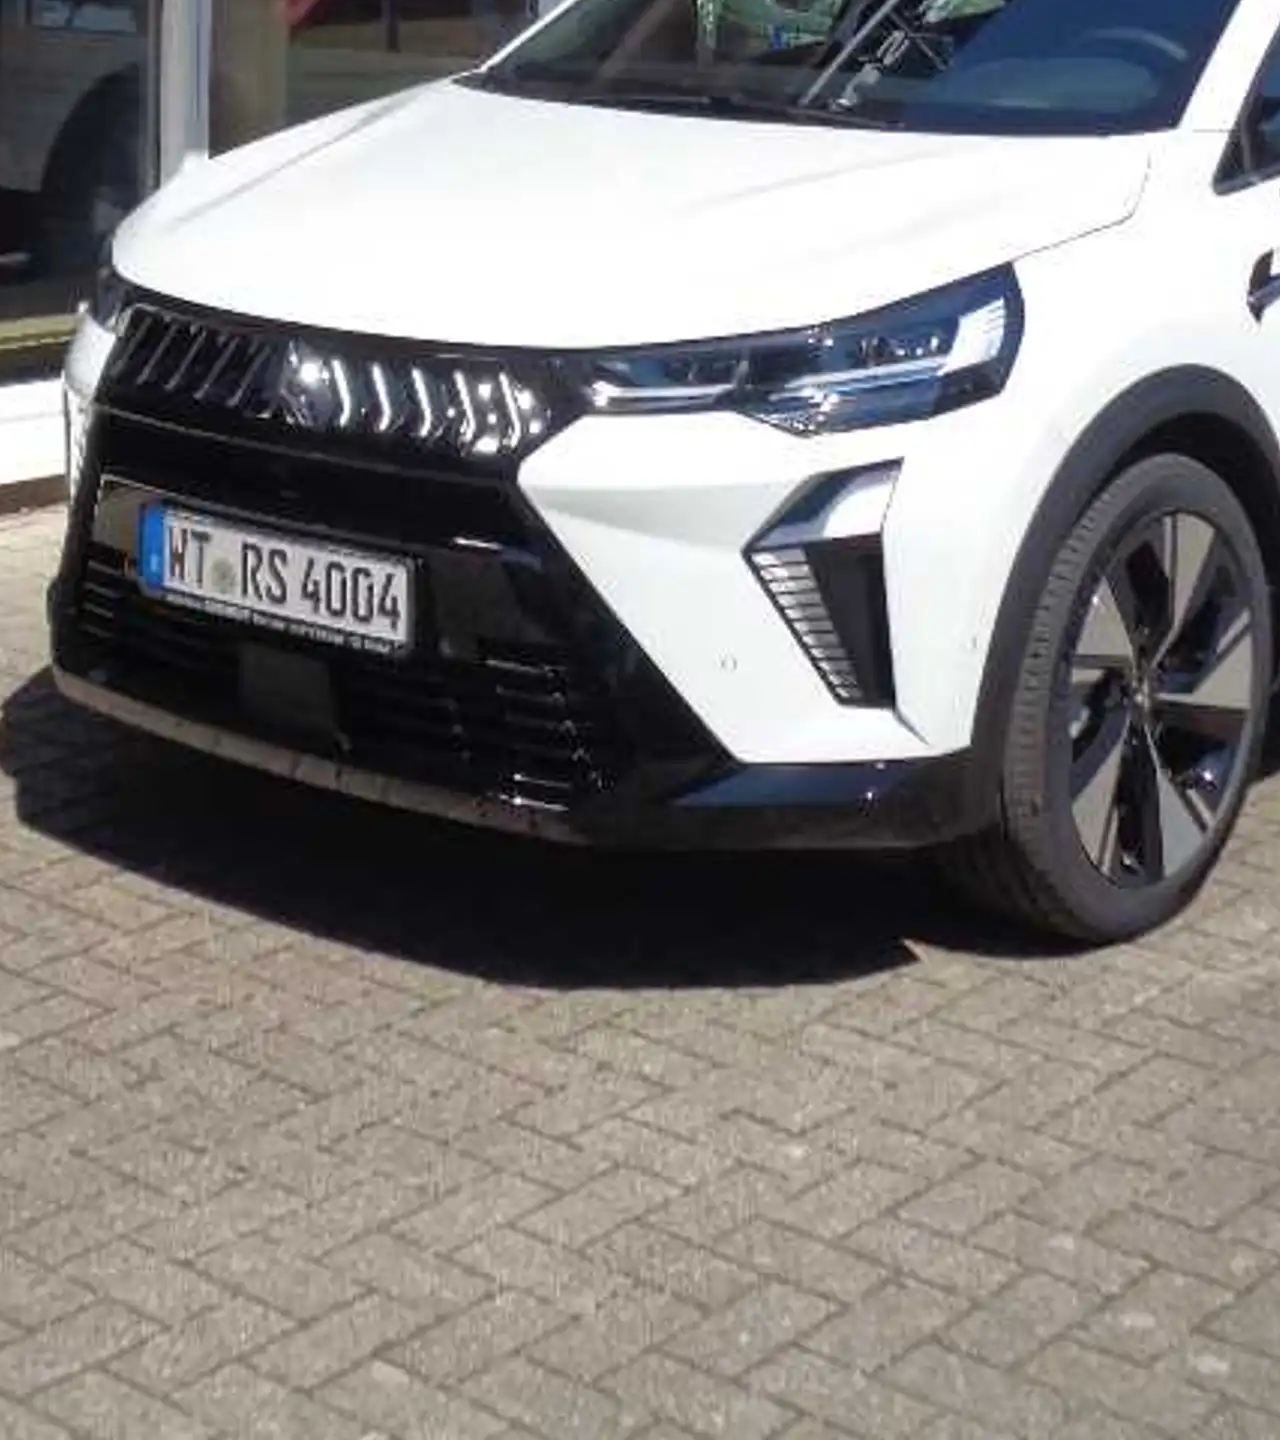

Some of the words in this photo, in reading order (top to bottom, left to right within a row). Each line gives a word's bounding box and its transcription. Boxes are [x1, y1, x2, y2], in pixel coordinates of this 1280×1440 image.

[169, 526, 211, 589] WT
[241, 542, 288, 604] RS
[300, 558, 402, 631] 4004
